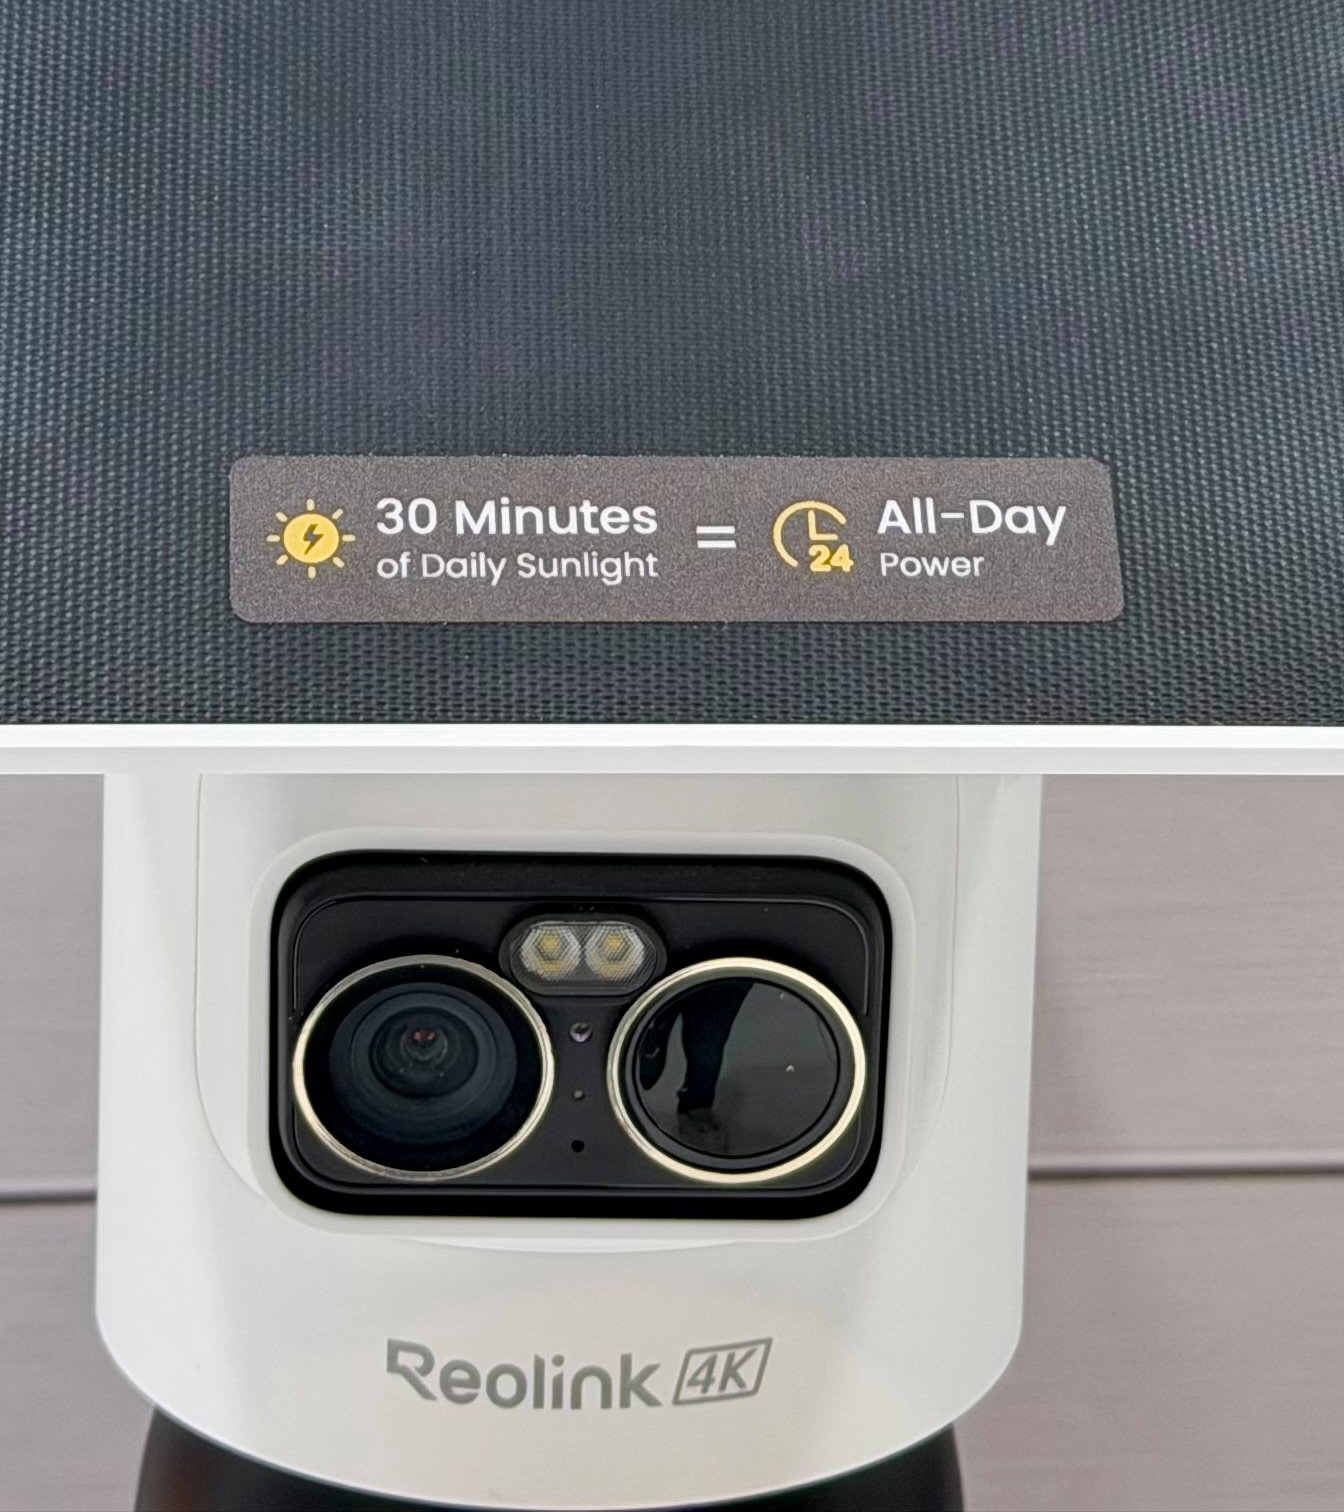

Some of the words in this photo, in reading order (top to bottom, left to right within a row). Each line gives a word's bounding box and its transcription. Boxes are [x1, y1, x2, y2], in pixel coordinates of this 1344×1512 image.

[376, 497, 438, 535] 30
[455, 496, 658, 535] Minutes
[877, 497, 1067, 546] All-Day
[376, 551, 411, 579] of
[421, 551, 507, 586] Daily
[517, 551, 659, 586] Sunlight
[808, 544, 854, 572] 24
[880, 552, 984, 577] Power
[386, 1337, 663, 1410] Reolink
[685, 1350, 756, 1395] 4K
